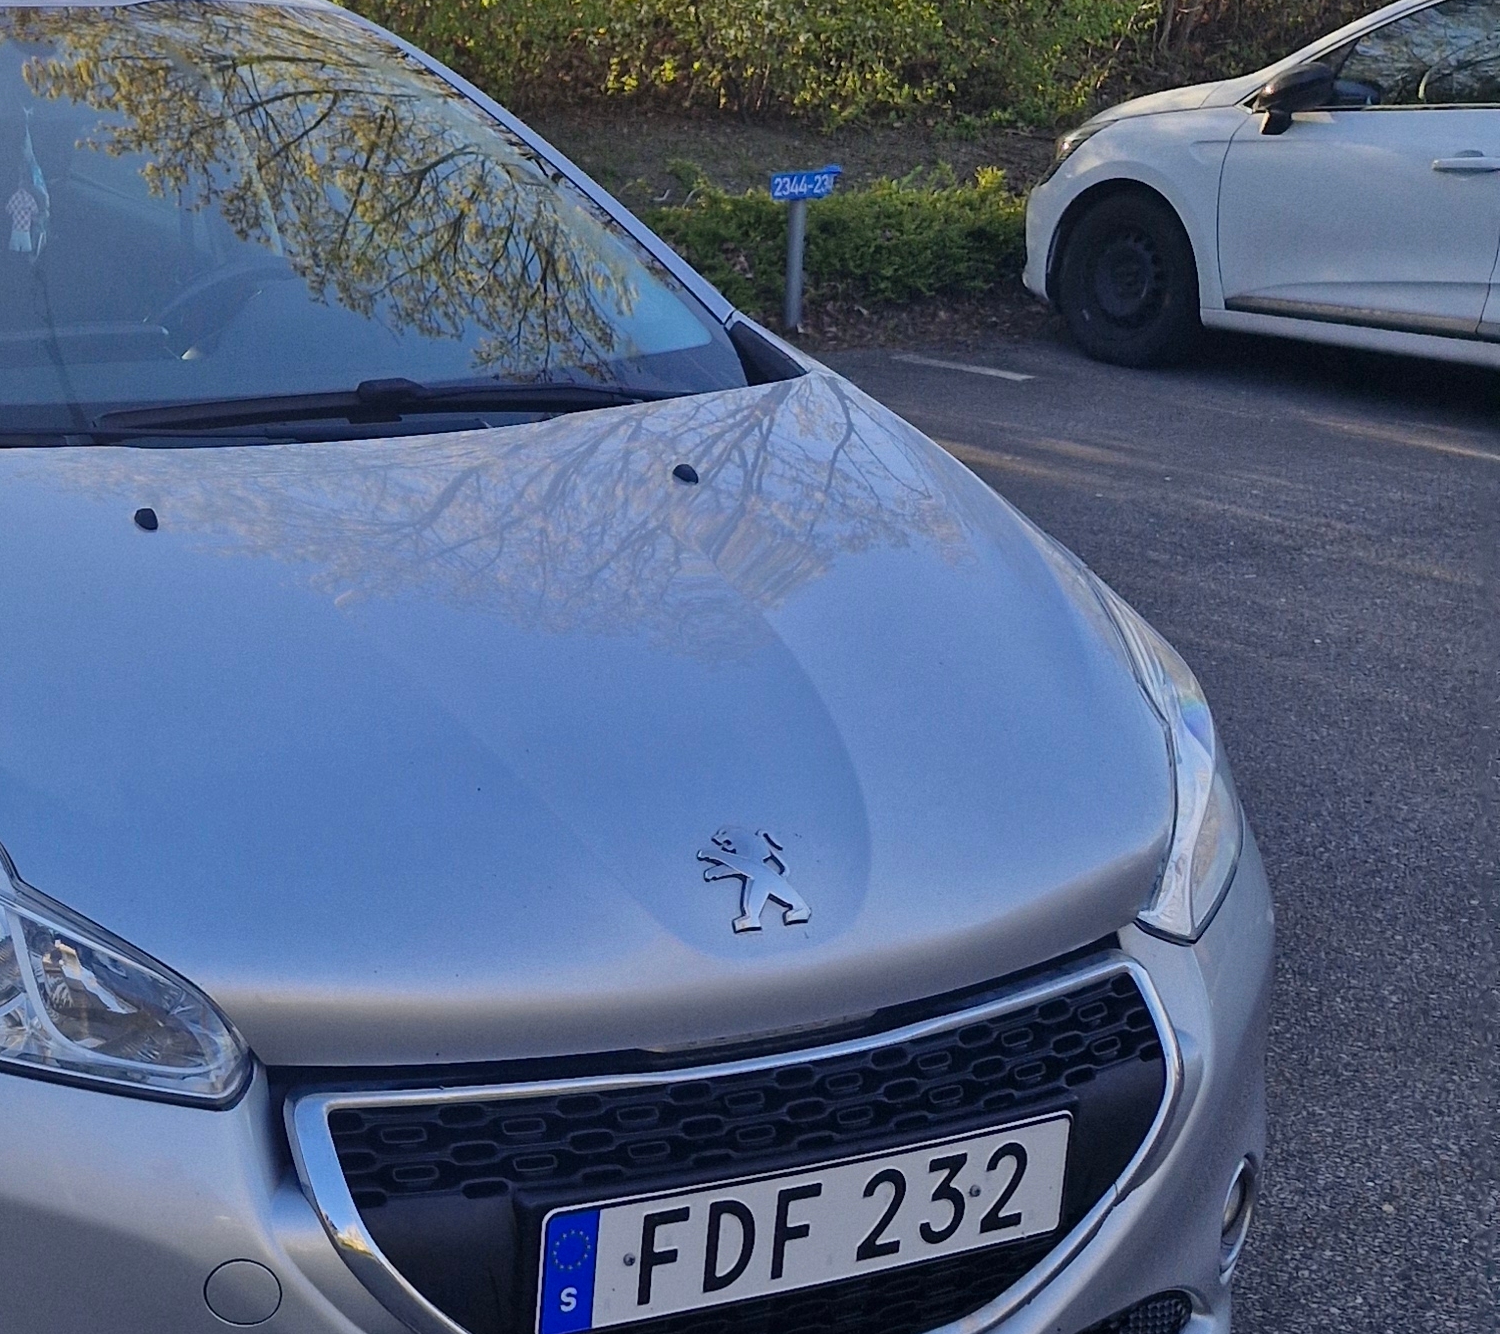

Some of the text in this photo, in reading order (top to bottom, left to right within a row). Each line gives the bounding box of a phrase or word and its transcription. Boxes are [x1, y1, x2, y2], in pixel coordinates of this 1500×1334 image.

[637, 1142, 1029, 1307] FDF 232
[559, 1287, 578, 1313] S
